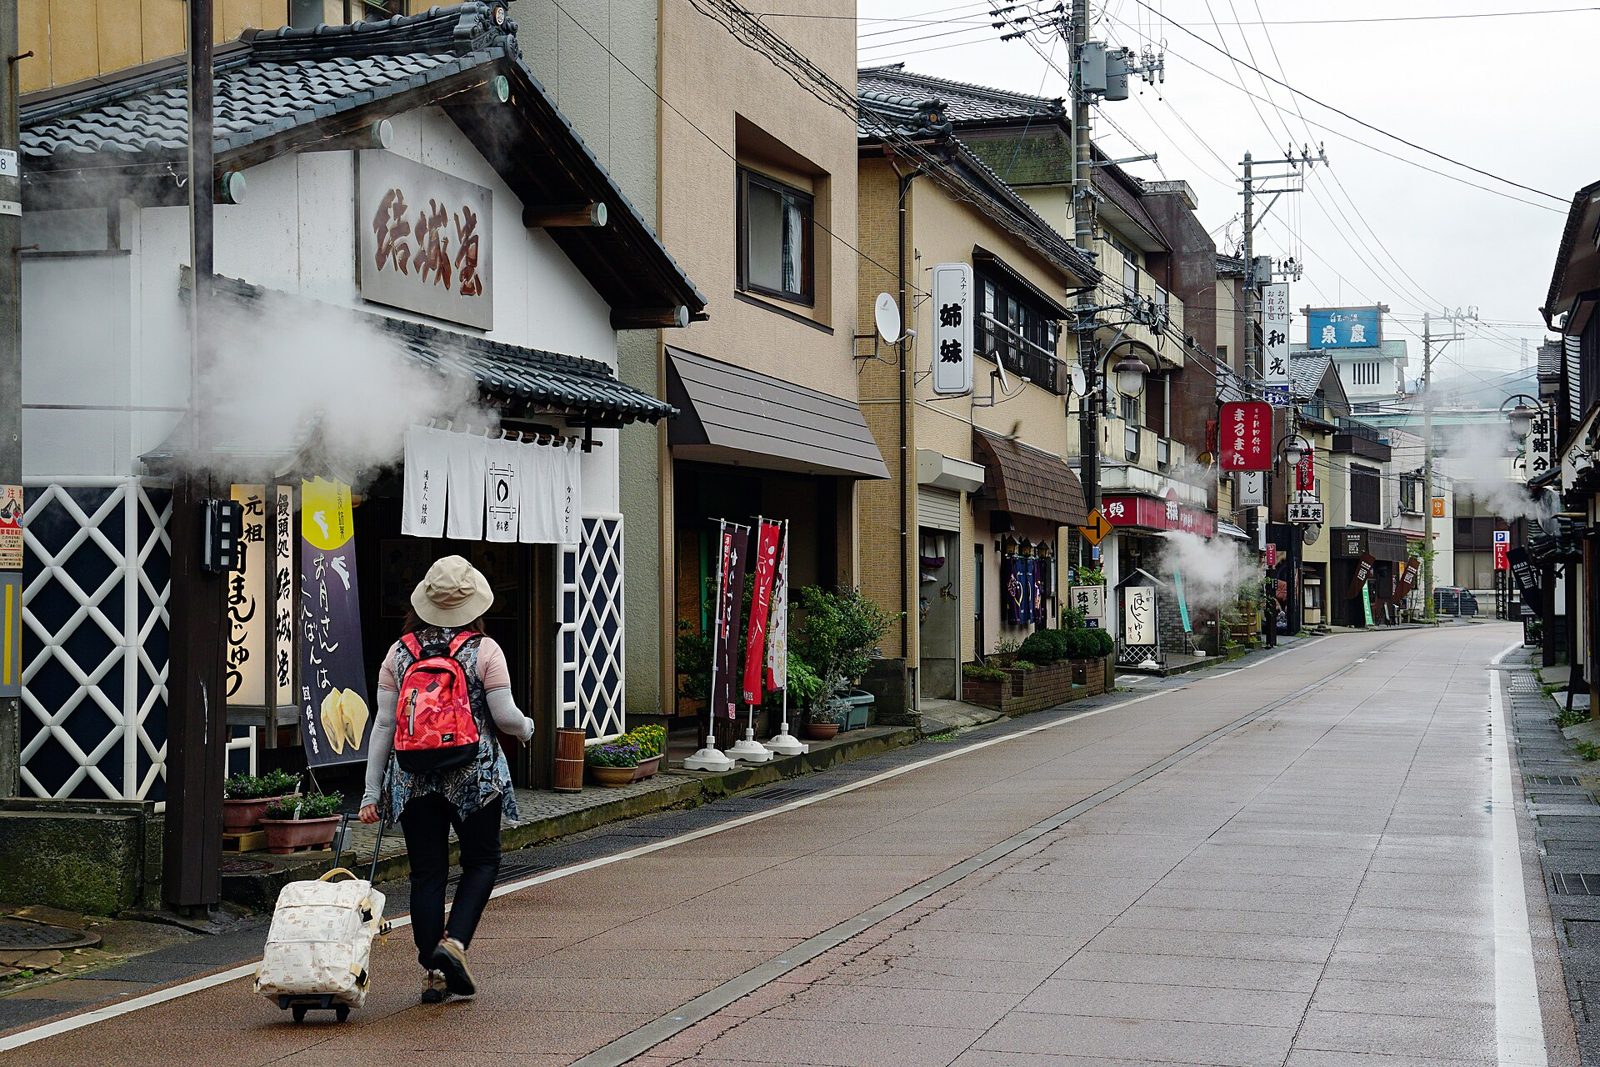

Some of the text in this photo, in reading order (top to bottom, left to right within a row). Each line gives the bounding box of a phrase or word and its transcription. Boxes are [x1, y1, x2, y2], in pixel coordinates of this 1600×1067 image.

[1277, 290, 1285, 320] おみやげ
[940, 303, 963, 364] 姉妹
[1267, 330, 1286, 376] 和光
[1232, 408, 1246, 466] まるまた
[243, 494, 265, 543] 元祖
[1290, 508, 1322, 518] 清風苑
[313, 552, 338, 653] お月さん
[1077, 591, 1090, 616] 姉妹
[301, 573, 332, 689] こんばんは
